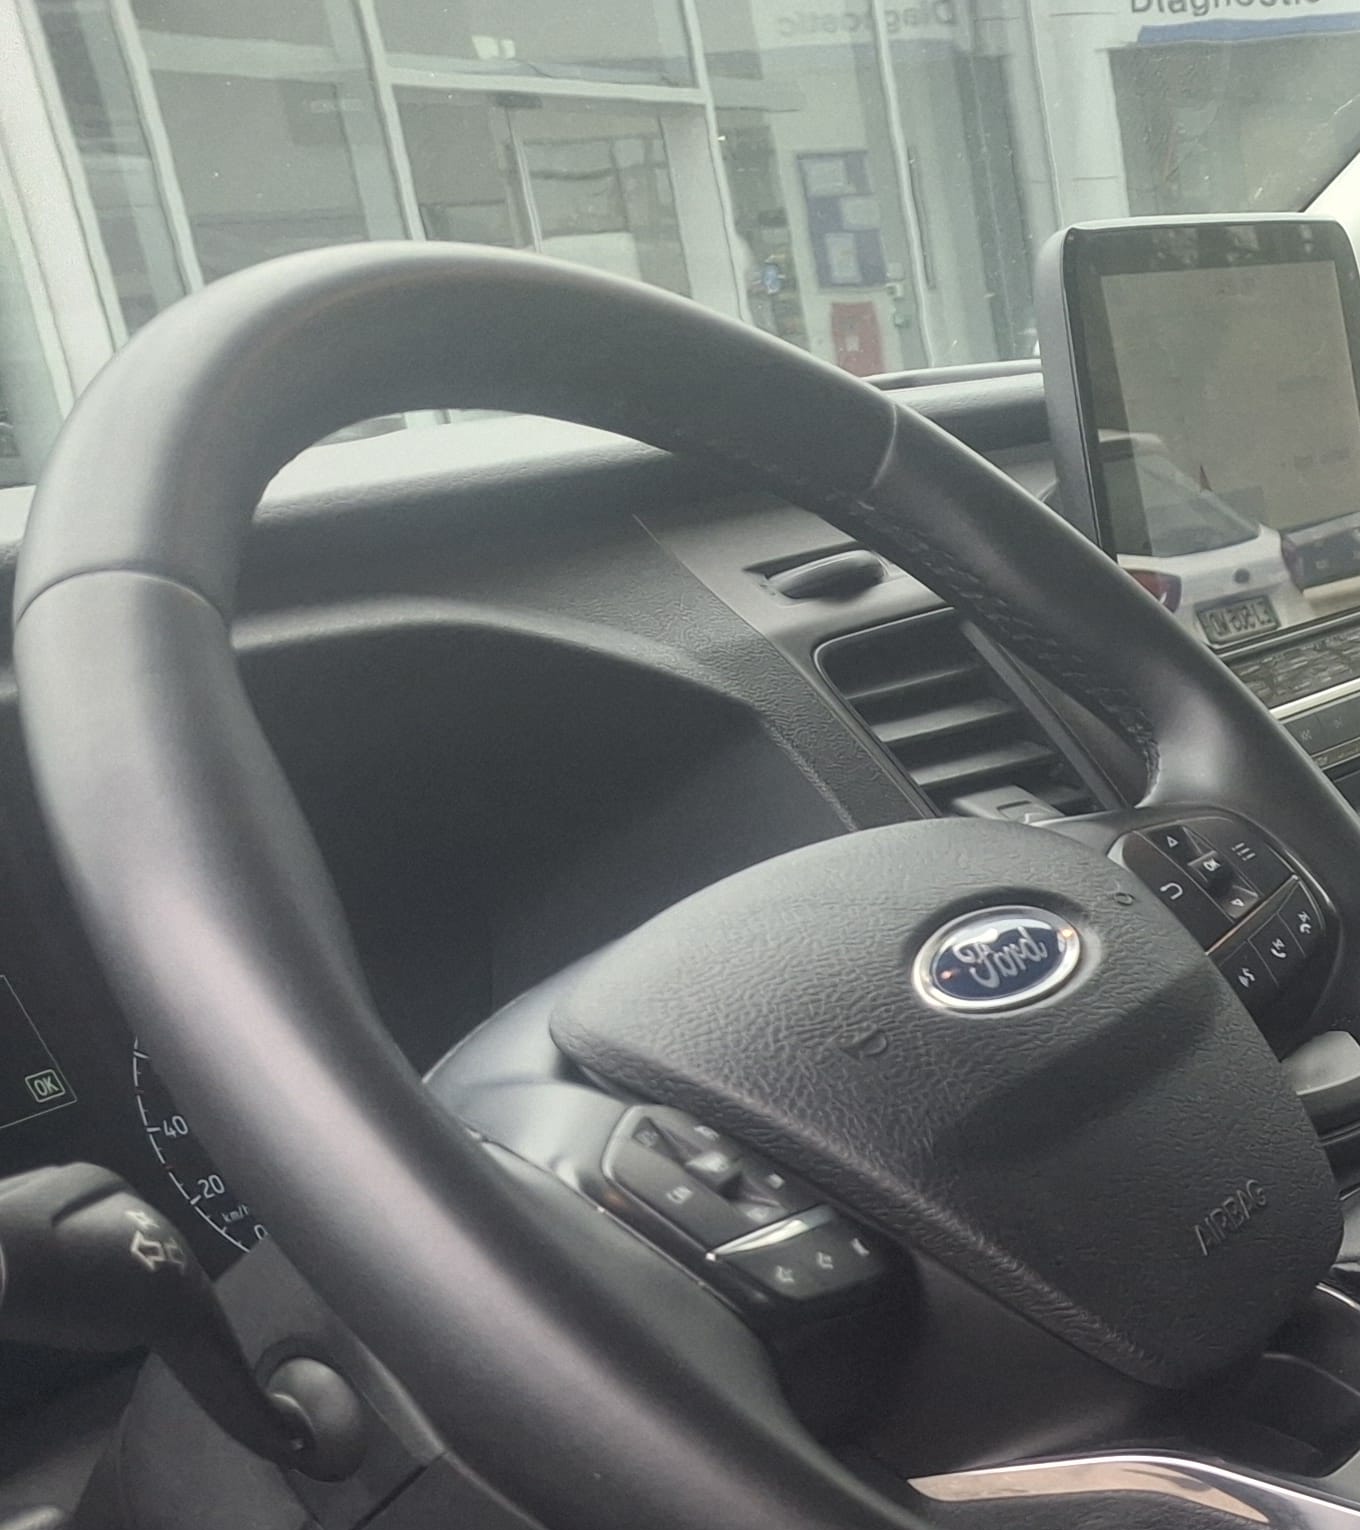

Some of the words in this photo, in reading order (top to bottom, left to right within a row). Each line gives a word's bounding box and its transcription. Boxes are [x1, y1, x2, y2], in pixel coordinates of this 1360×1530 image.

[953, 926, 1048, 988] Ford
[34, 1079, 59, 1096] OK
[163, 1115, 188, 1138] 40
[197, 1174, 225, 1200] 20
[1194, 1179, 1266, 1256] AIRBAG
